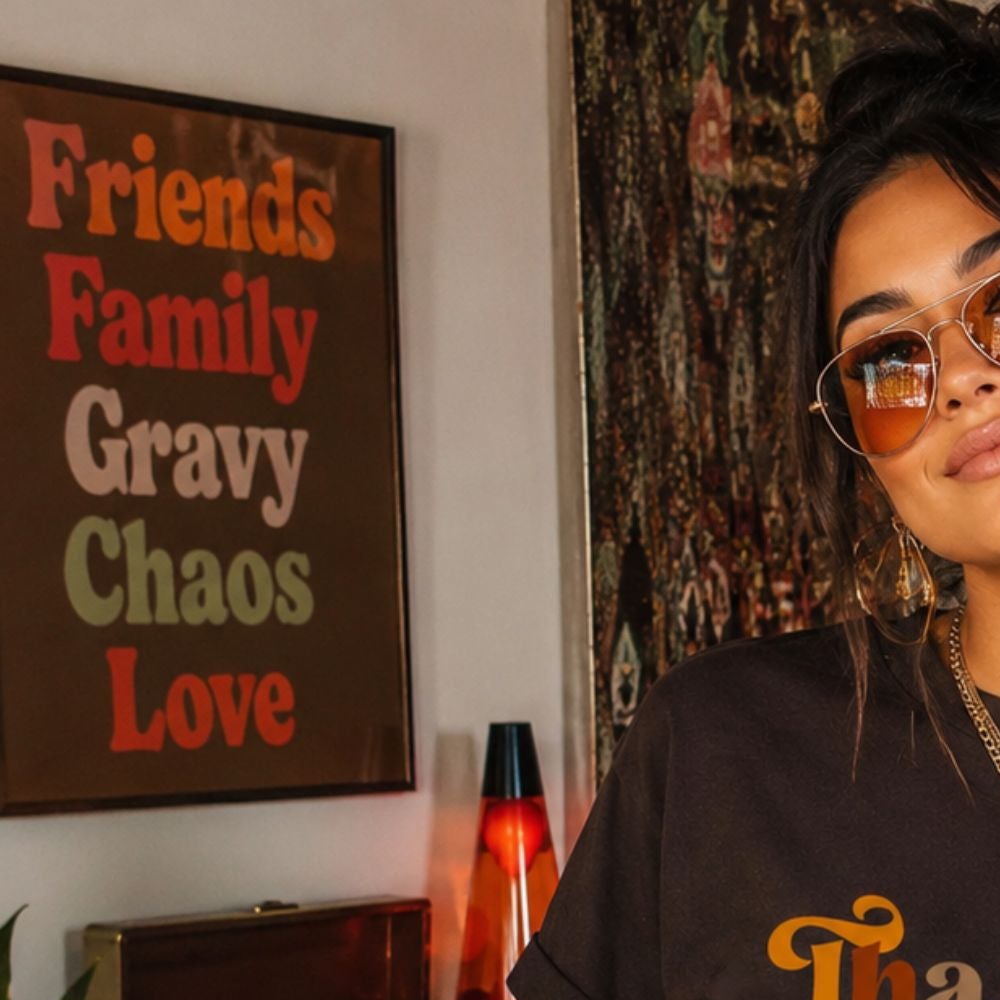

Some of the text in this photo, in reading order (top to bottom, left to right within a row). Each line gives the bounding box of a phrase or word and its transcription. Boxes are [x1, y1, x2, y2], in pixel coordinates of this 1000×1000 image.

[25, 119, 336, 262] Friends
[46, 253, 317, 406] Family
[64, 384, 309, 528] Gravy
[63, 516, 315, 627] Chaos
[108, 648, 296, 753] Love
